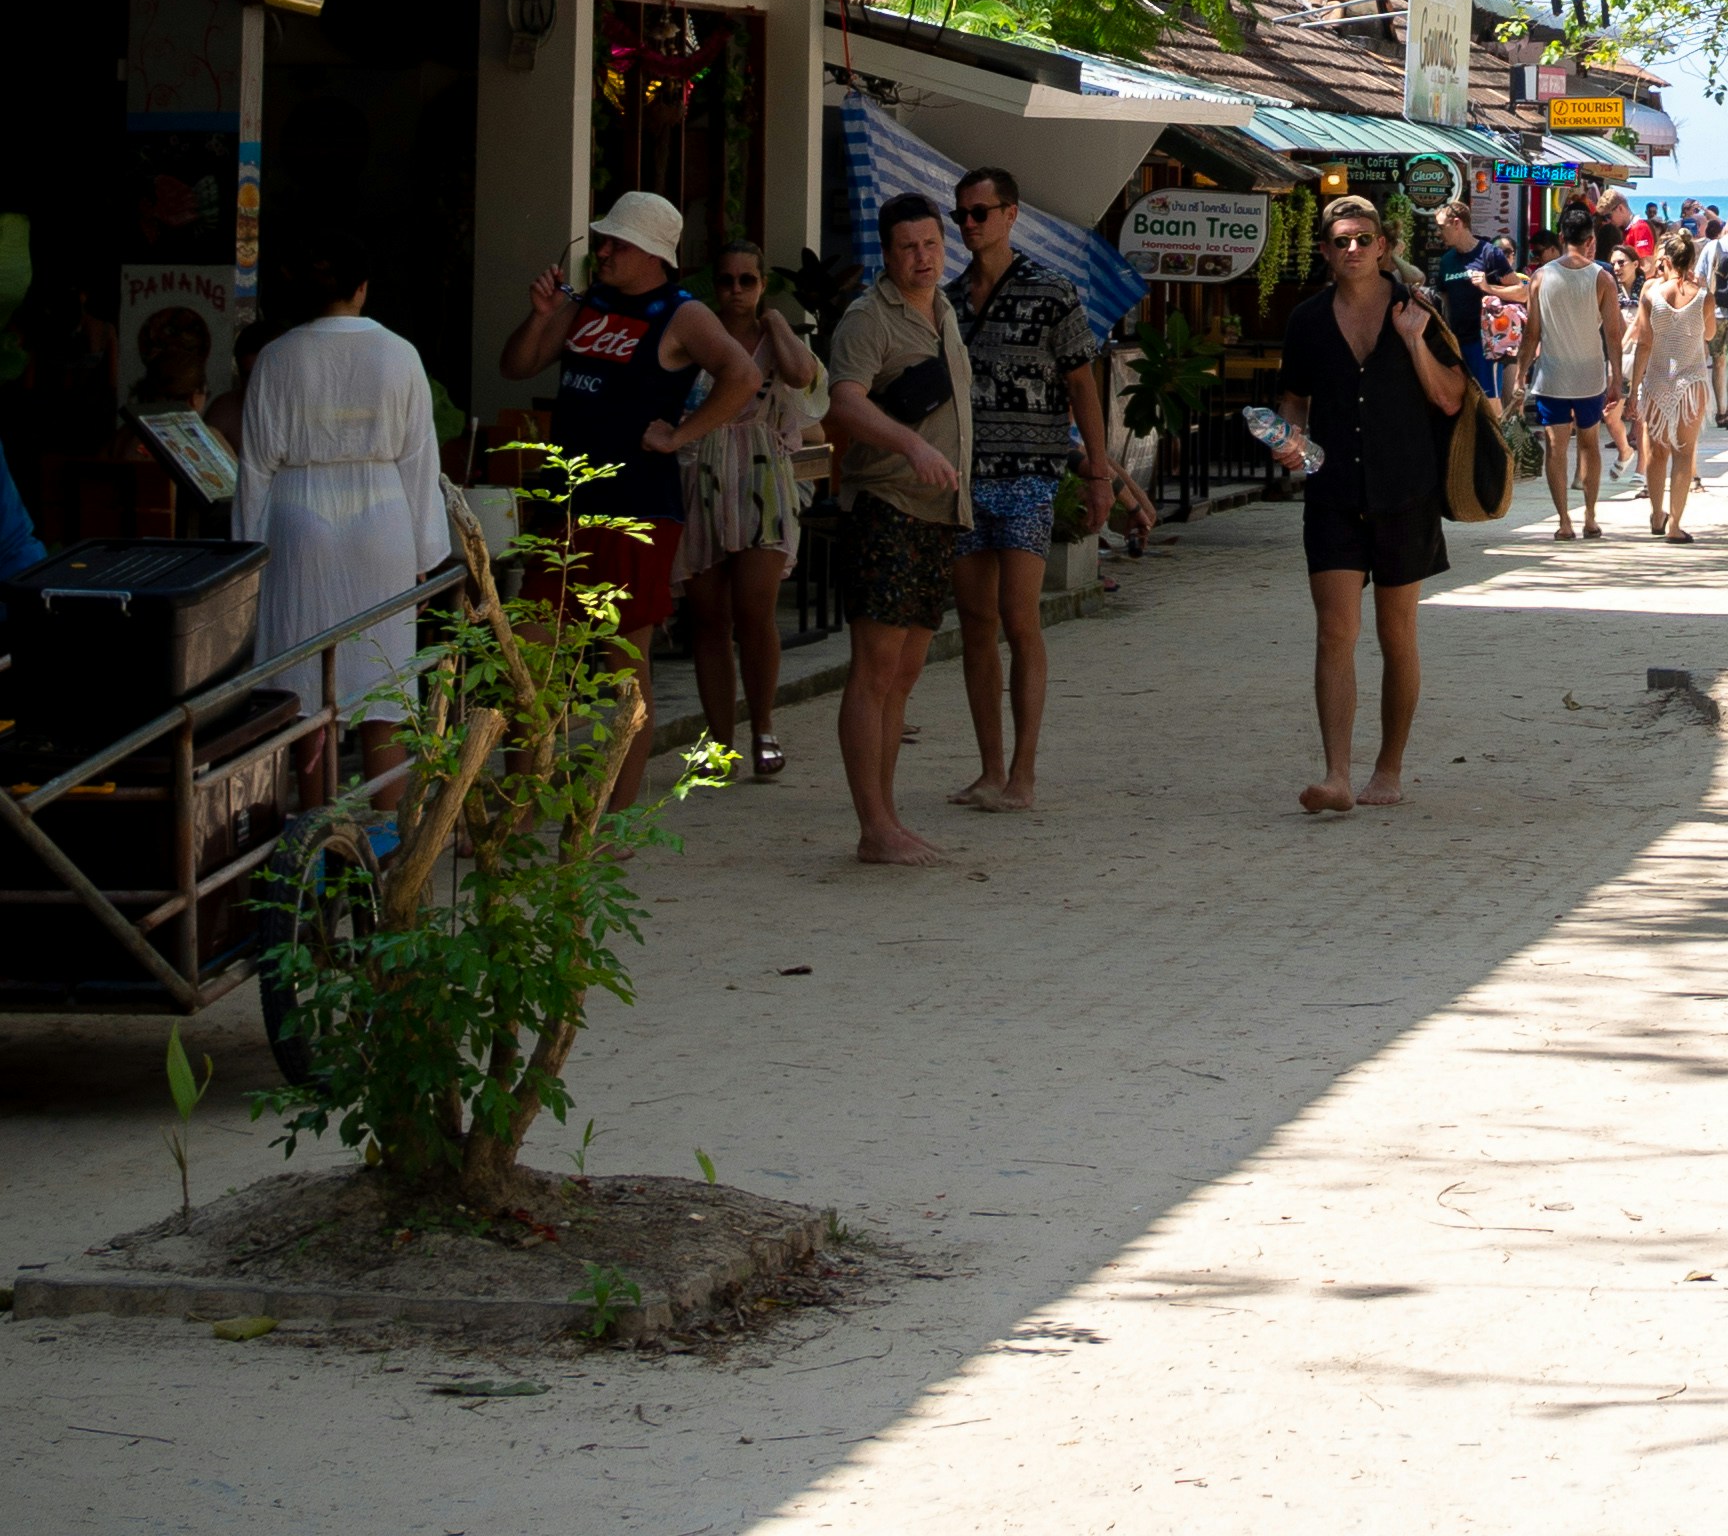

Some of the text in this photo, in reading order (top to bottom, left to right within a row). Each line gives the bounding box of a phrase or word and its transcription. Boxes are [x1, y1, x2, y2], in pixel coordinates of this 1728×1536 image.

[1571, 101, 1620, 113] TOURIST
[1553, 116, 1621, 125] INFORMATION
[1496, 163, 1577, 180] Fruit Shake
[1134, 213, 1259, 240] Baan Tree
[1142, 240, 1255, 254] Homemade Ice Cream
[564, 314, 640, 357] Lete
[570, 373, 602, 393] MSC
